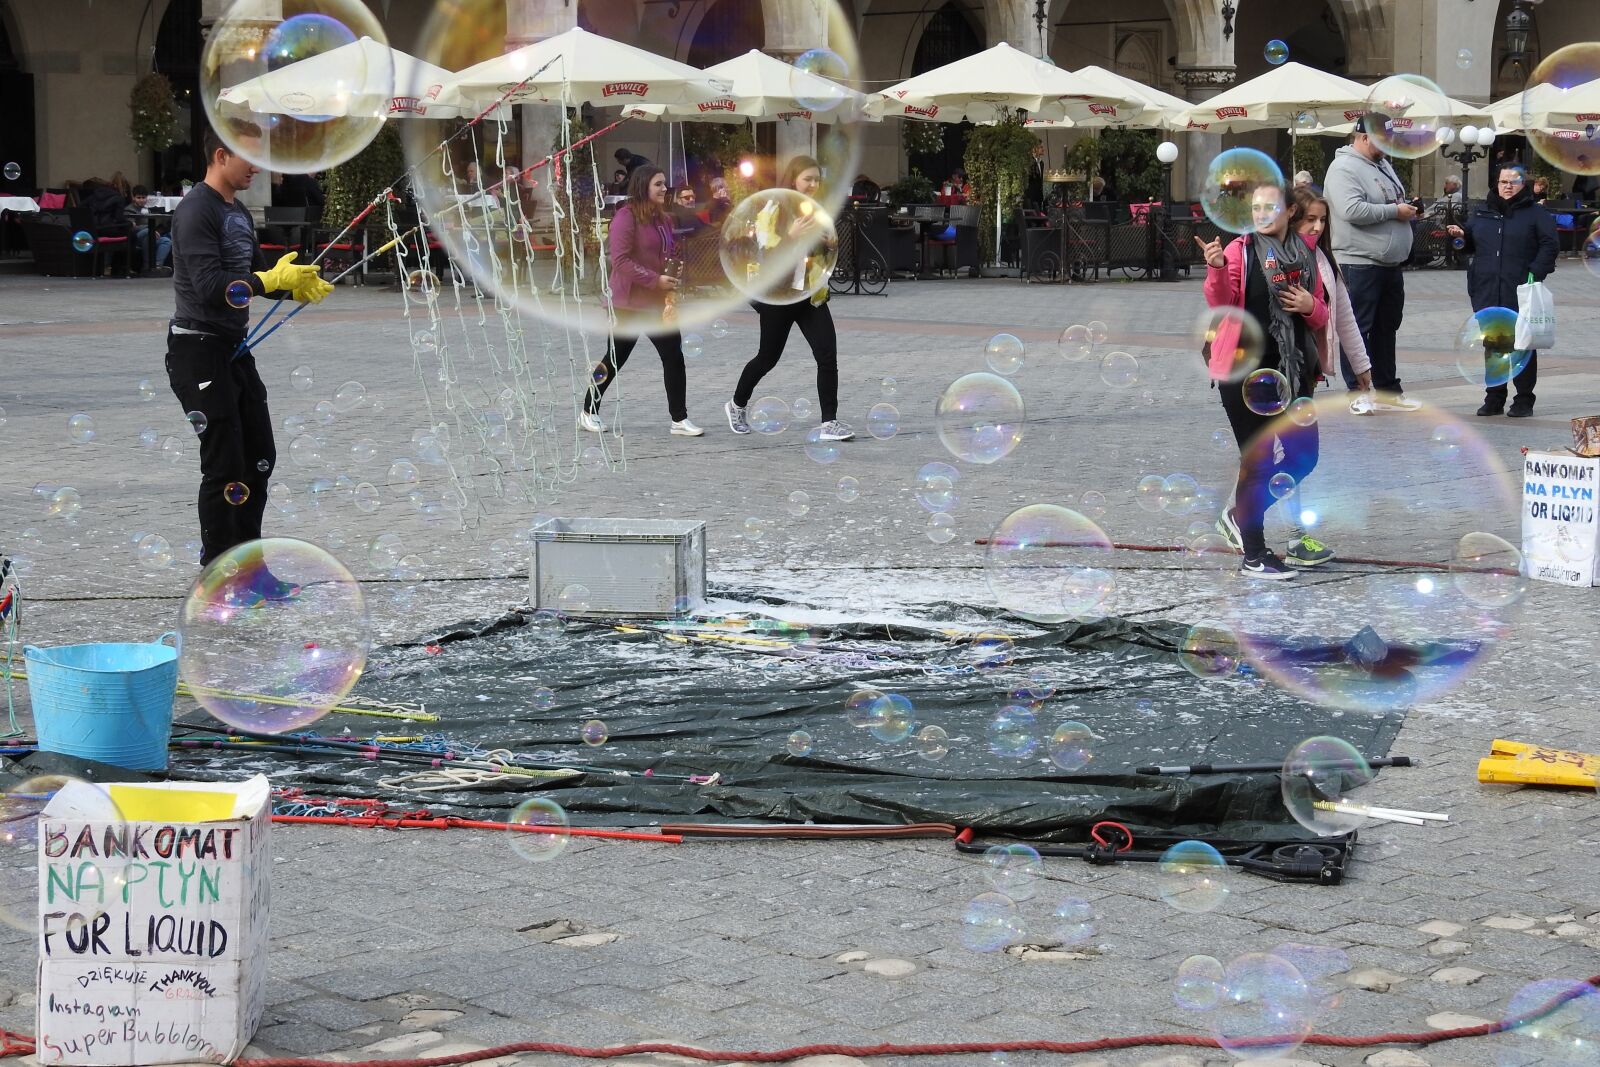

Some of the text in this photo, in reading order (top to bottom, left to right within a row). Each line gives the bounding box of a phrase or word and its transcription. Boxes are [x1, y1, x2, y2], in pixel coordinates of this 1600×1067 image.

[1526, 460, 1594, 480] BANKOMAT
[1526, 482, 1547, 496] NA
[44, 823, 241, 859] BANKOMAT
[47, 861, 104, 904] NA
[44, 911, 228, 959] FOR LIQUID
[49, 993, 141, 1022] Instagram
